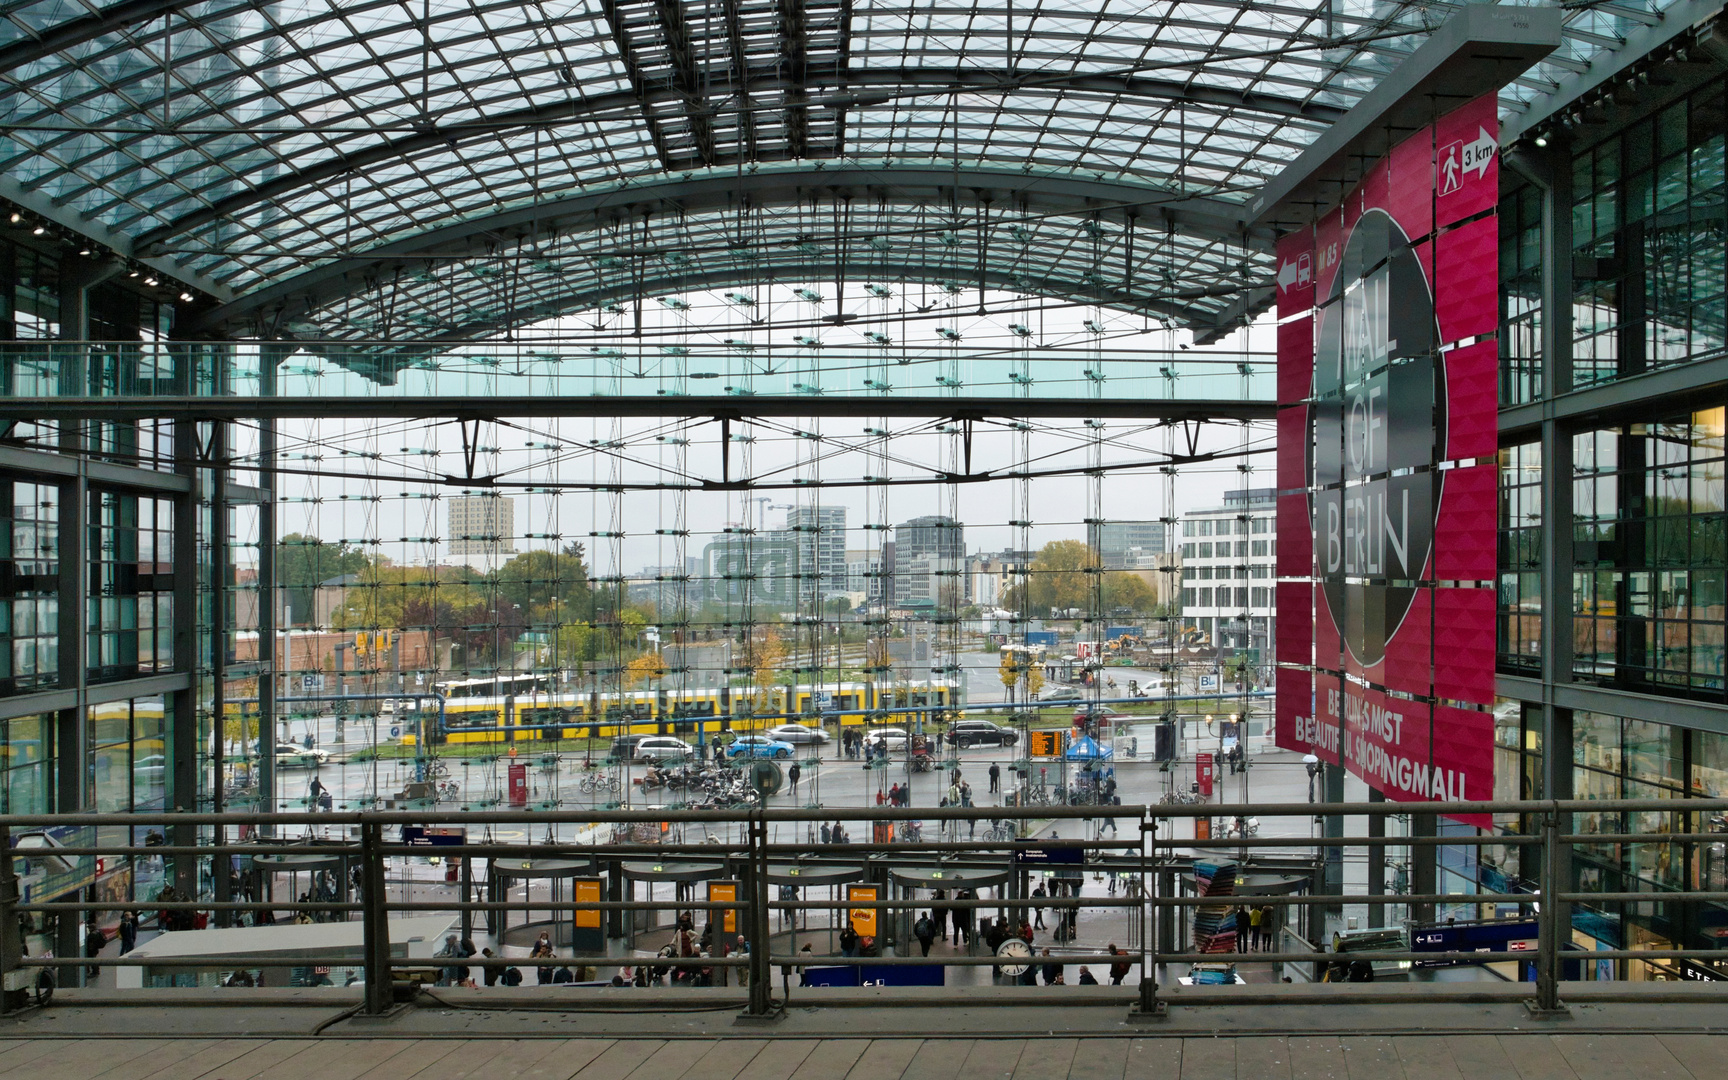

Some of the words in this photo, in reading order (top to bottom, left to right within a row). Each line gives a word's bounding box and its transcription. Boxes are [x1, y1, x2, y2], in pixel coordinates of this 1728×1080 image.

[1465, 150, 1472, 167] 3
[1475, 144, 1493, 162] km
[1319, 249, 1326, 271] M
[1327, 242, 1337, 267] 85
[1349, 386, 1381, 473] OF
[1327, 489, 1409, 578] BERLIN
[1687, 968, 1716, 982] ETE
